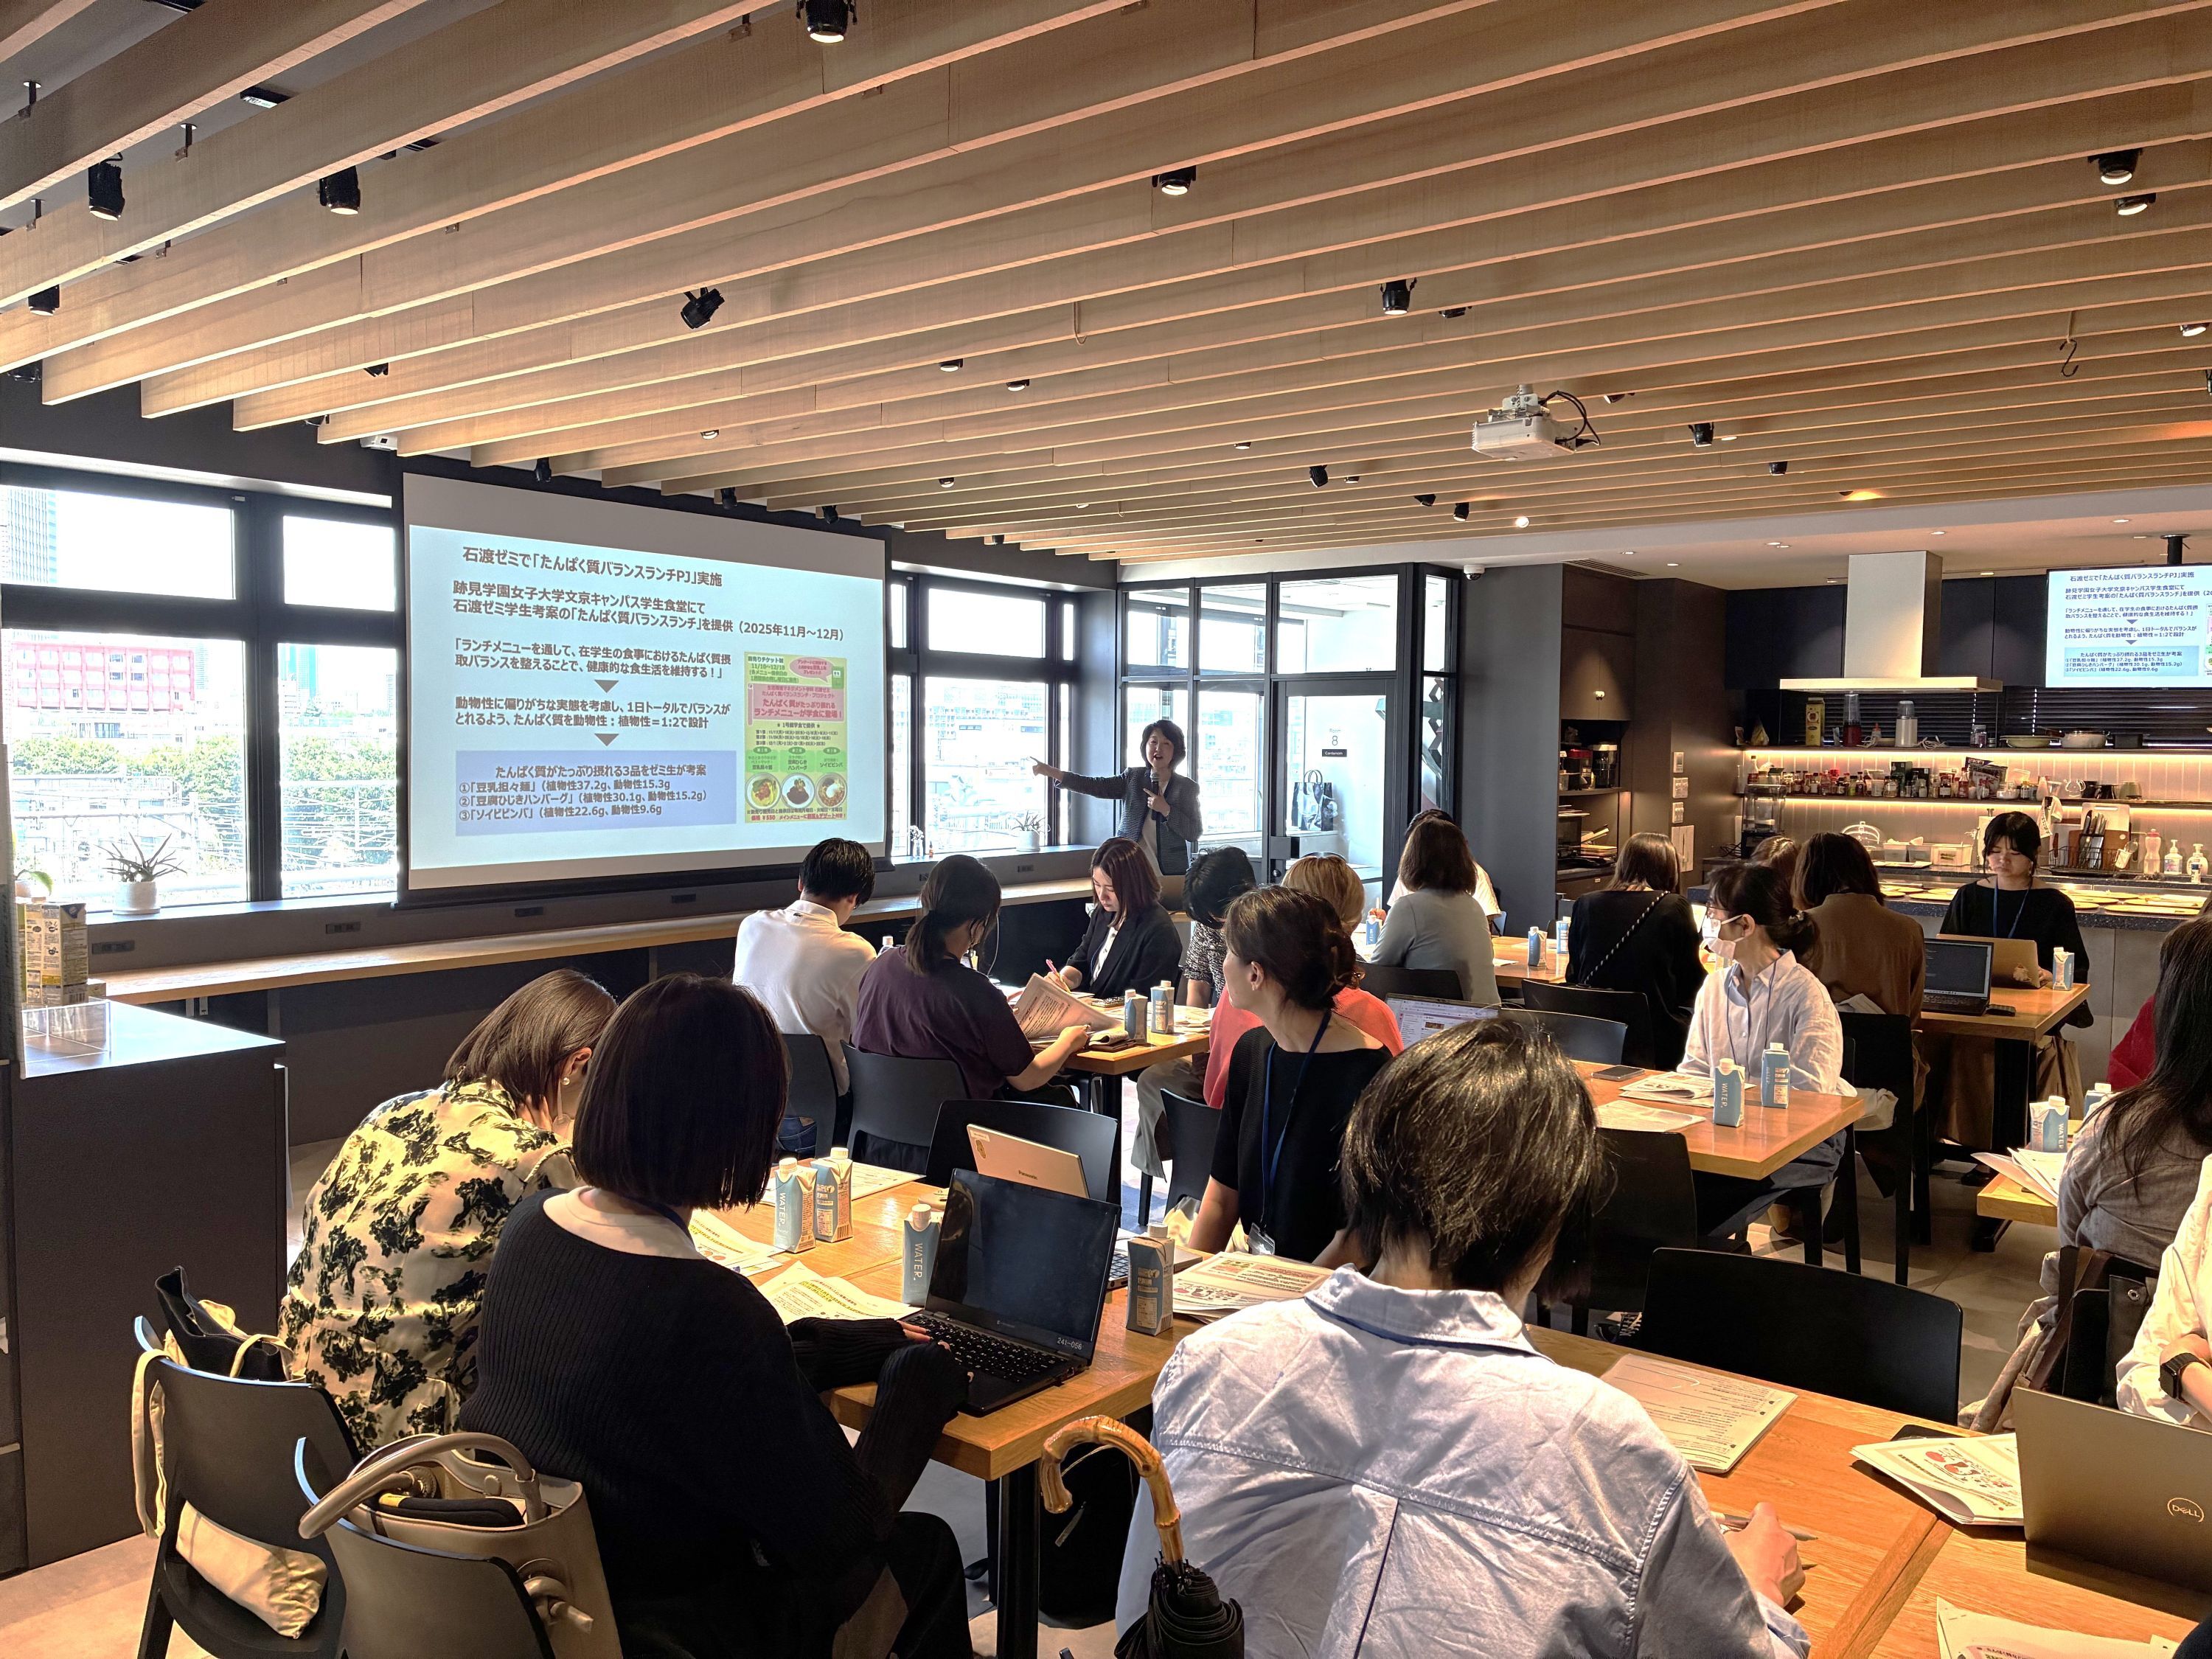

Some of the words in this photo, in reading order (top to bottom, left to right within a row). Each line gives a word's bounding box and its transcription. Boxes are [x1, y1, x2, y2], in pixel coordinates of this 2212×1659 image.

[462, 546, 723, 587] 石渡ゼミで「たんぱく質バランスランチPJ」実施
[453, 580, 706, 614] 跡見学園女子大学文京キャンパス学生食堂にて
[1332, 735, 1338, 745] 8
[495, 764, 707, 778] たんぱく質がたっぷり摂れる3品をゼミ生が考案
[778, 1192, 787, 1226] WATER.
[913, 1243, 923, 1281] WATER.
[2171, 1504, 2201, 1517] DELL
